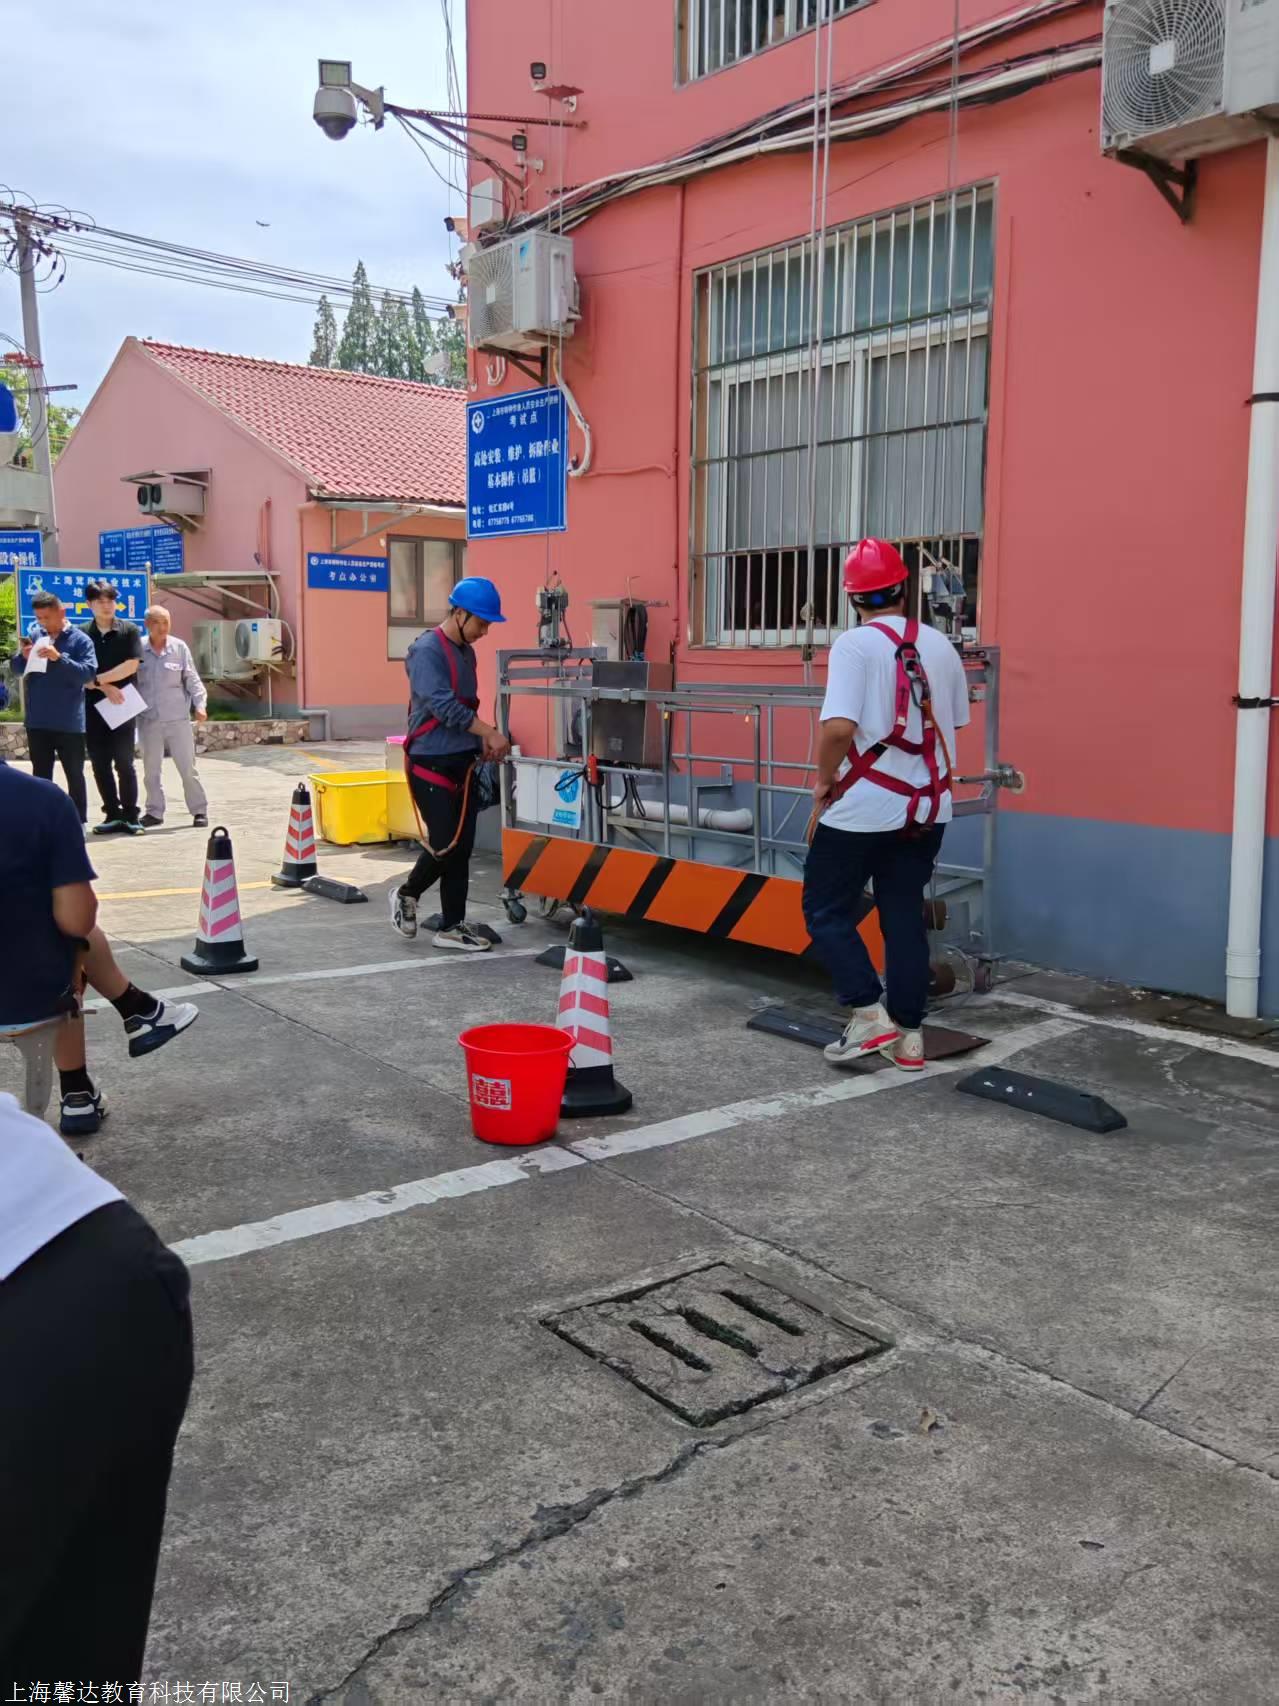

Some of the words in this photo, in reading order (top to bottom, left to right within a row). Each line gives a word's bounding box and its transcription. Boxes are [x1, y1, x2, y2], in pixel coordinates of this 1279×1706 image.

[509, 410, 538, 429] 考试点
[329, 571, 377, 583] 考点办公室
